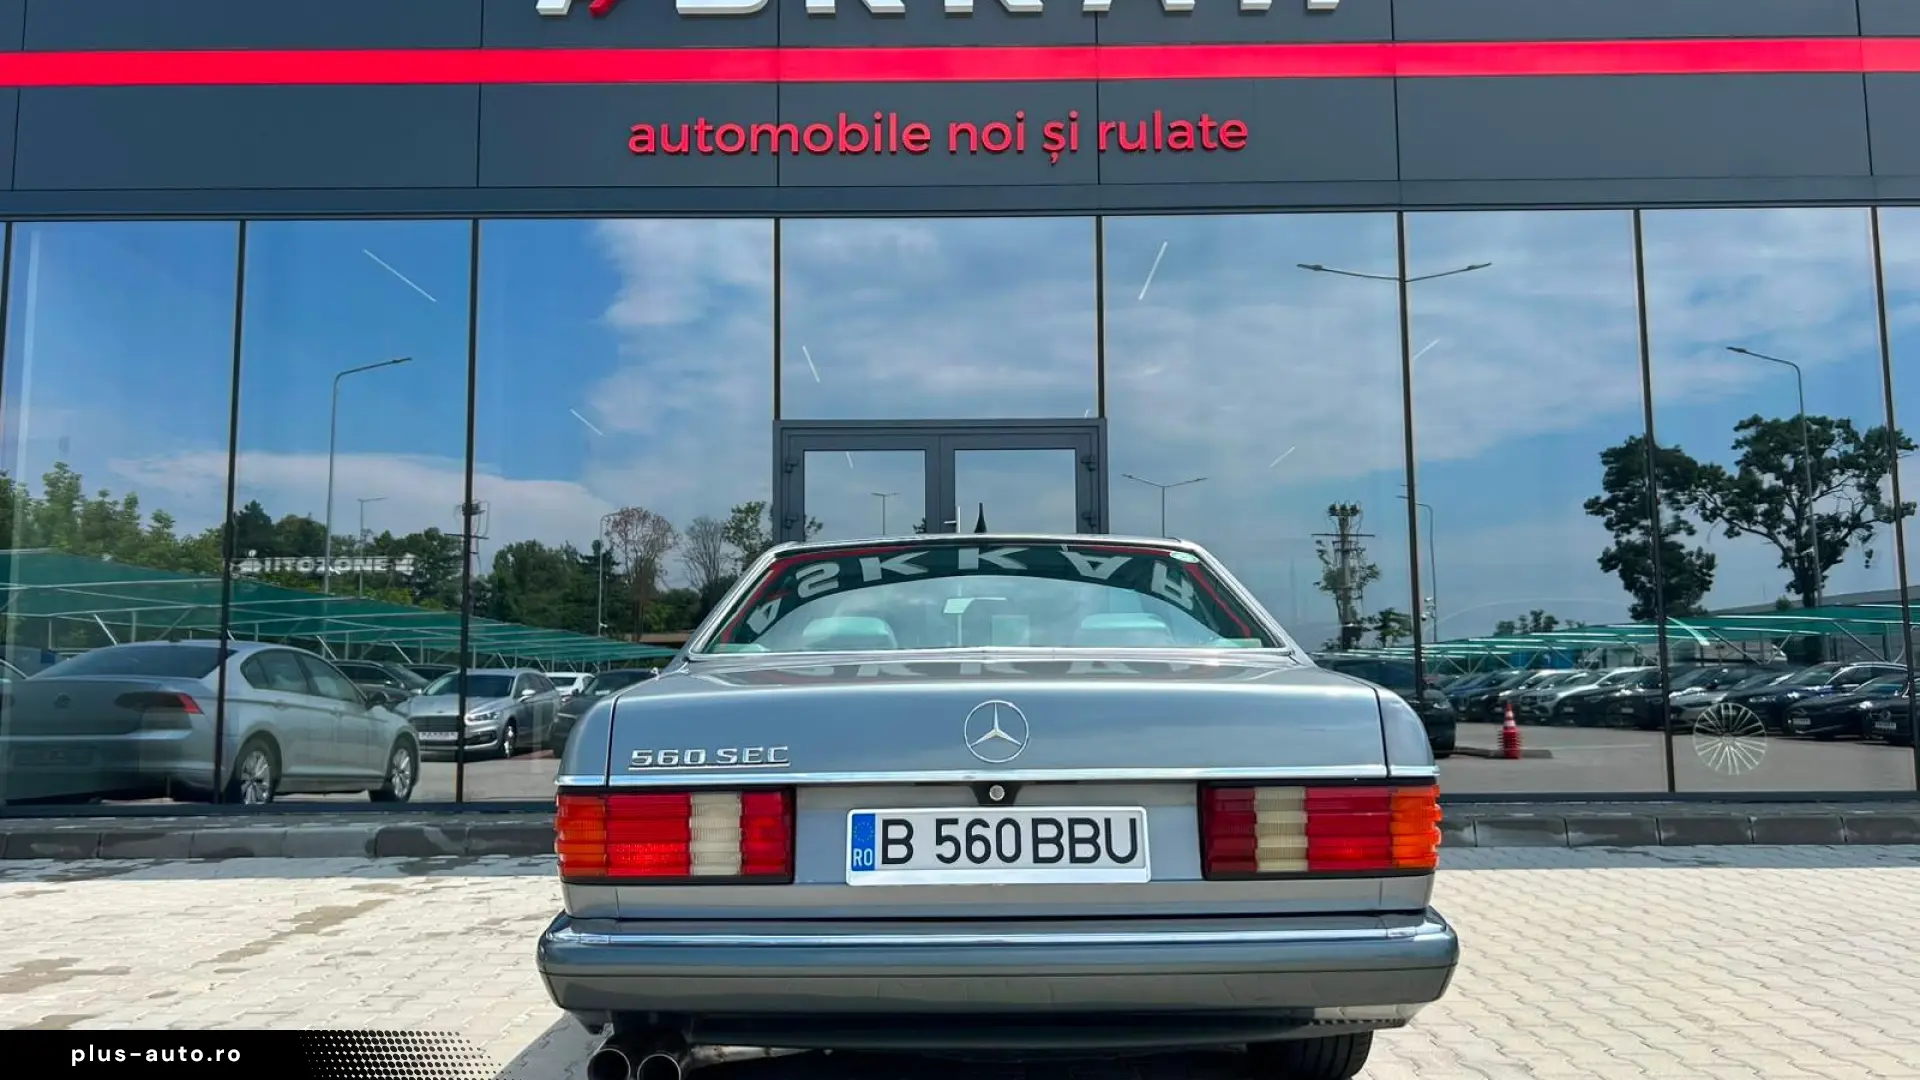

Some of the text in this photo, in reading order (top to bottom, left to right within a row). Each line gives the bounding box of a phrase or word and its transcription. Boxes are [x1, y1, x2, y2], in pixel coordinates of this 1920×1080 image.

[628, 109, 1248, 164] automobile noi și rulate
[631, 746, 789, 766] 560 SEC
[853, 848, 873, 866] RO
[881, 817, 1138, 865] B 560 BBU
